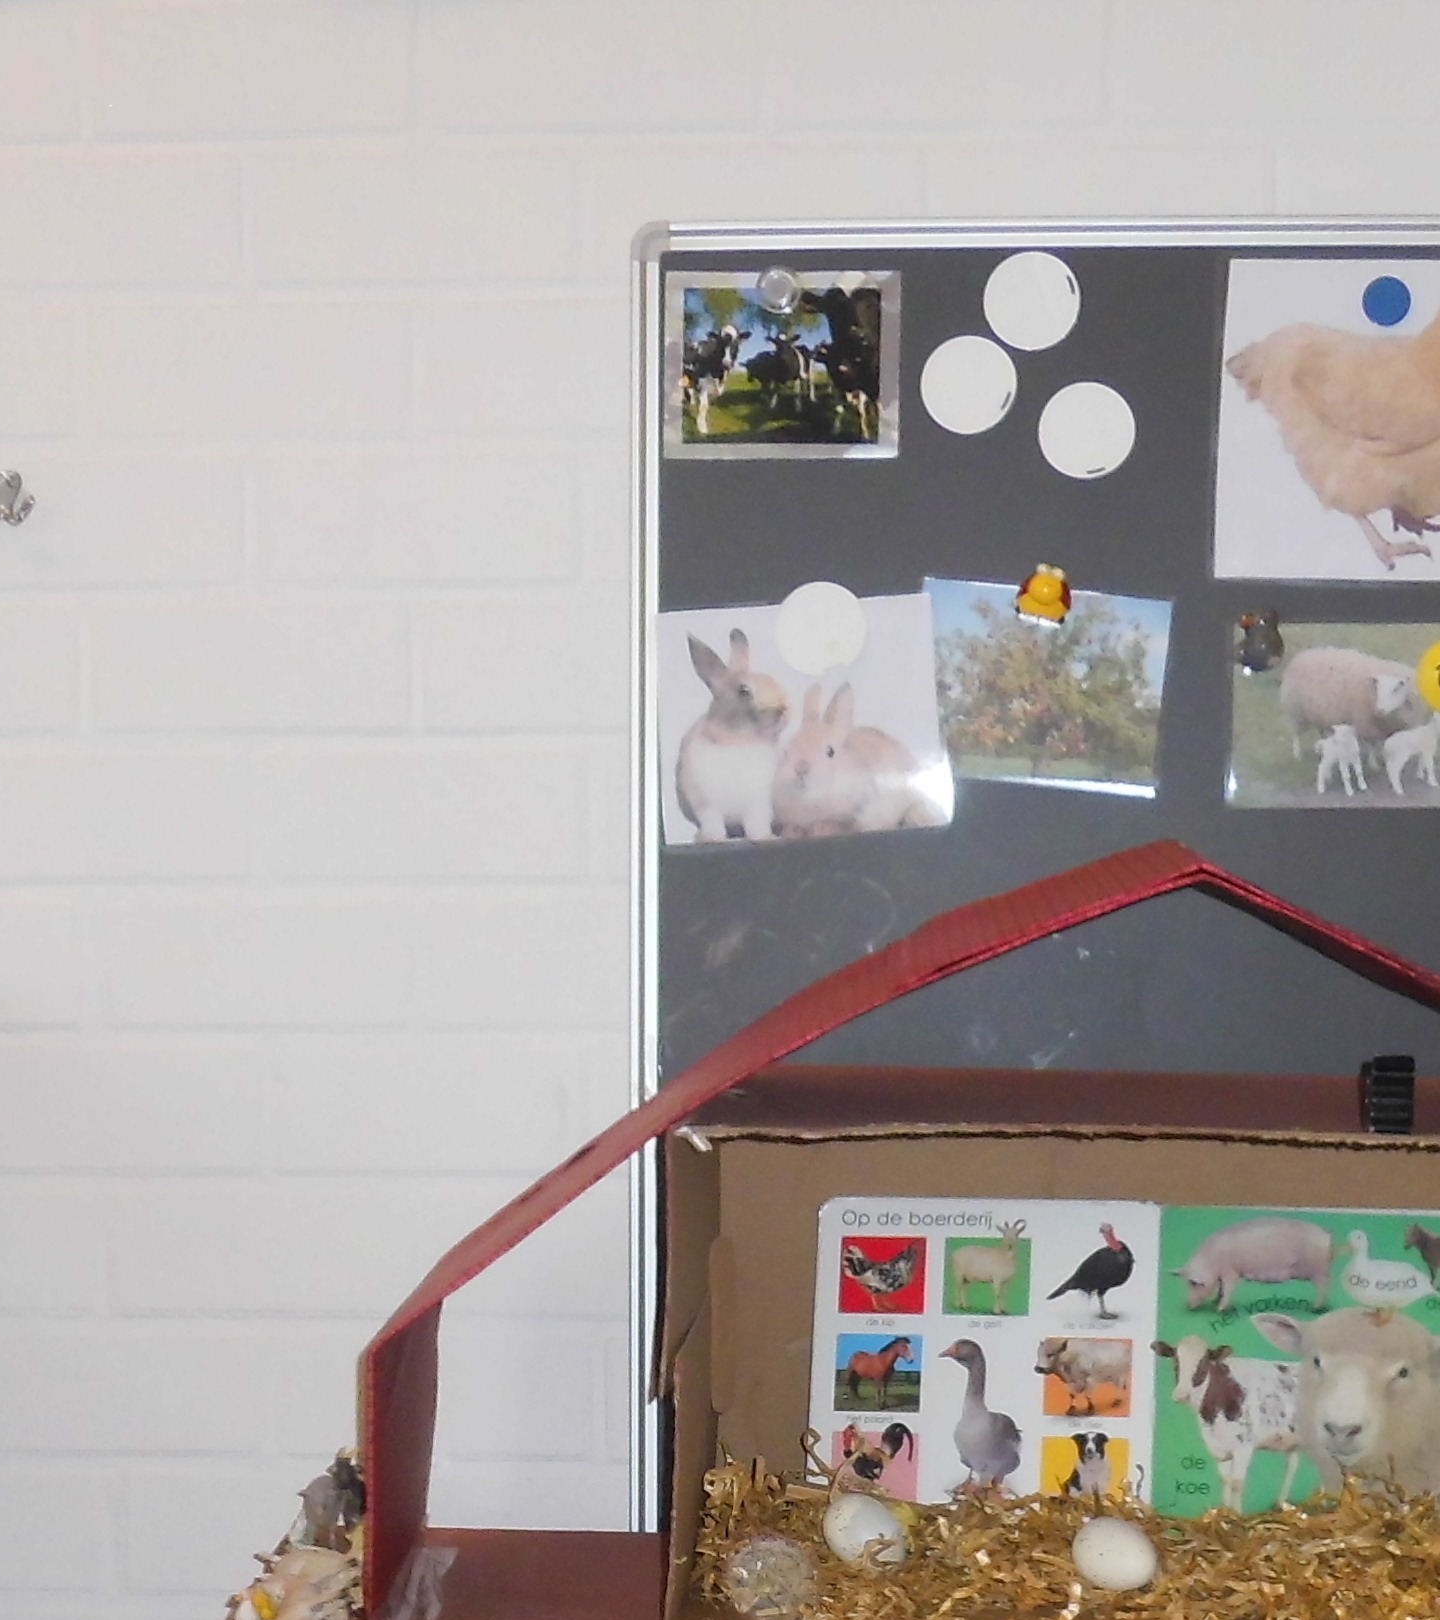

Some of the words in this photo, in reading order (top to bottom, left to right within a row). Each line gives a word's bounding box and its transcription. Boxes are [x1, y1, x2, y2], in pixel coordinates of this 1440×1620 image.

[841, 1209, 871, 1228] Op
[876, 1210, 903, 1226] de
[908, 1210, 993, 1230] boerderij
[1348, 1273, 1371, 1289] de
[1374, 1276, 1418, 1292] eend
[1180, 1453, 1206, 1471] de
[1175, 1478, 1211, 1495] koe
